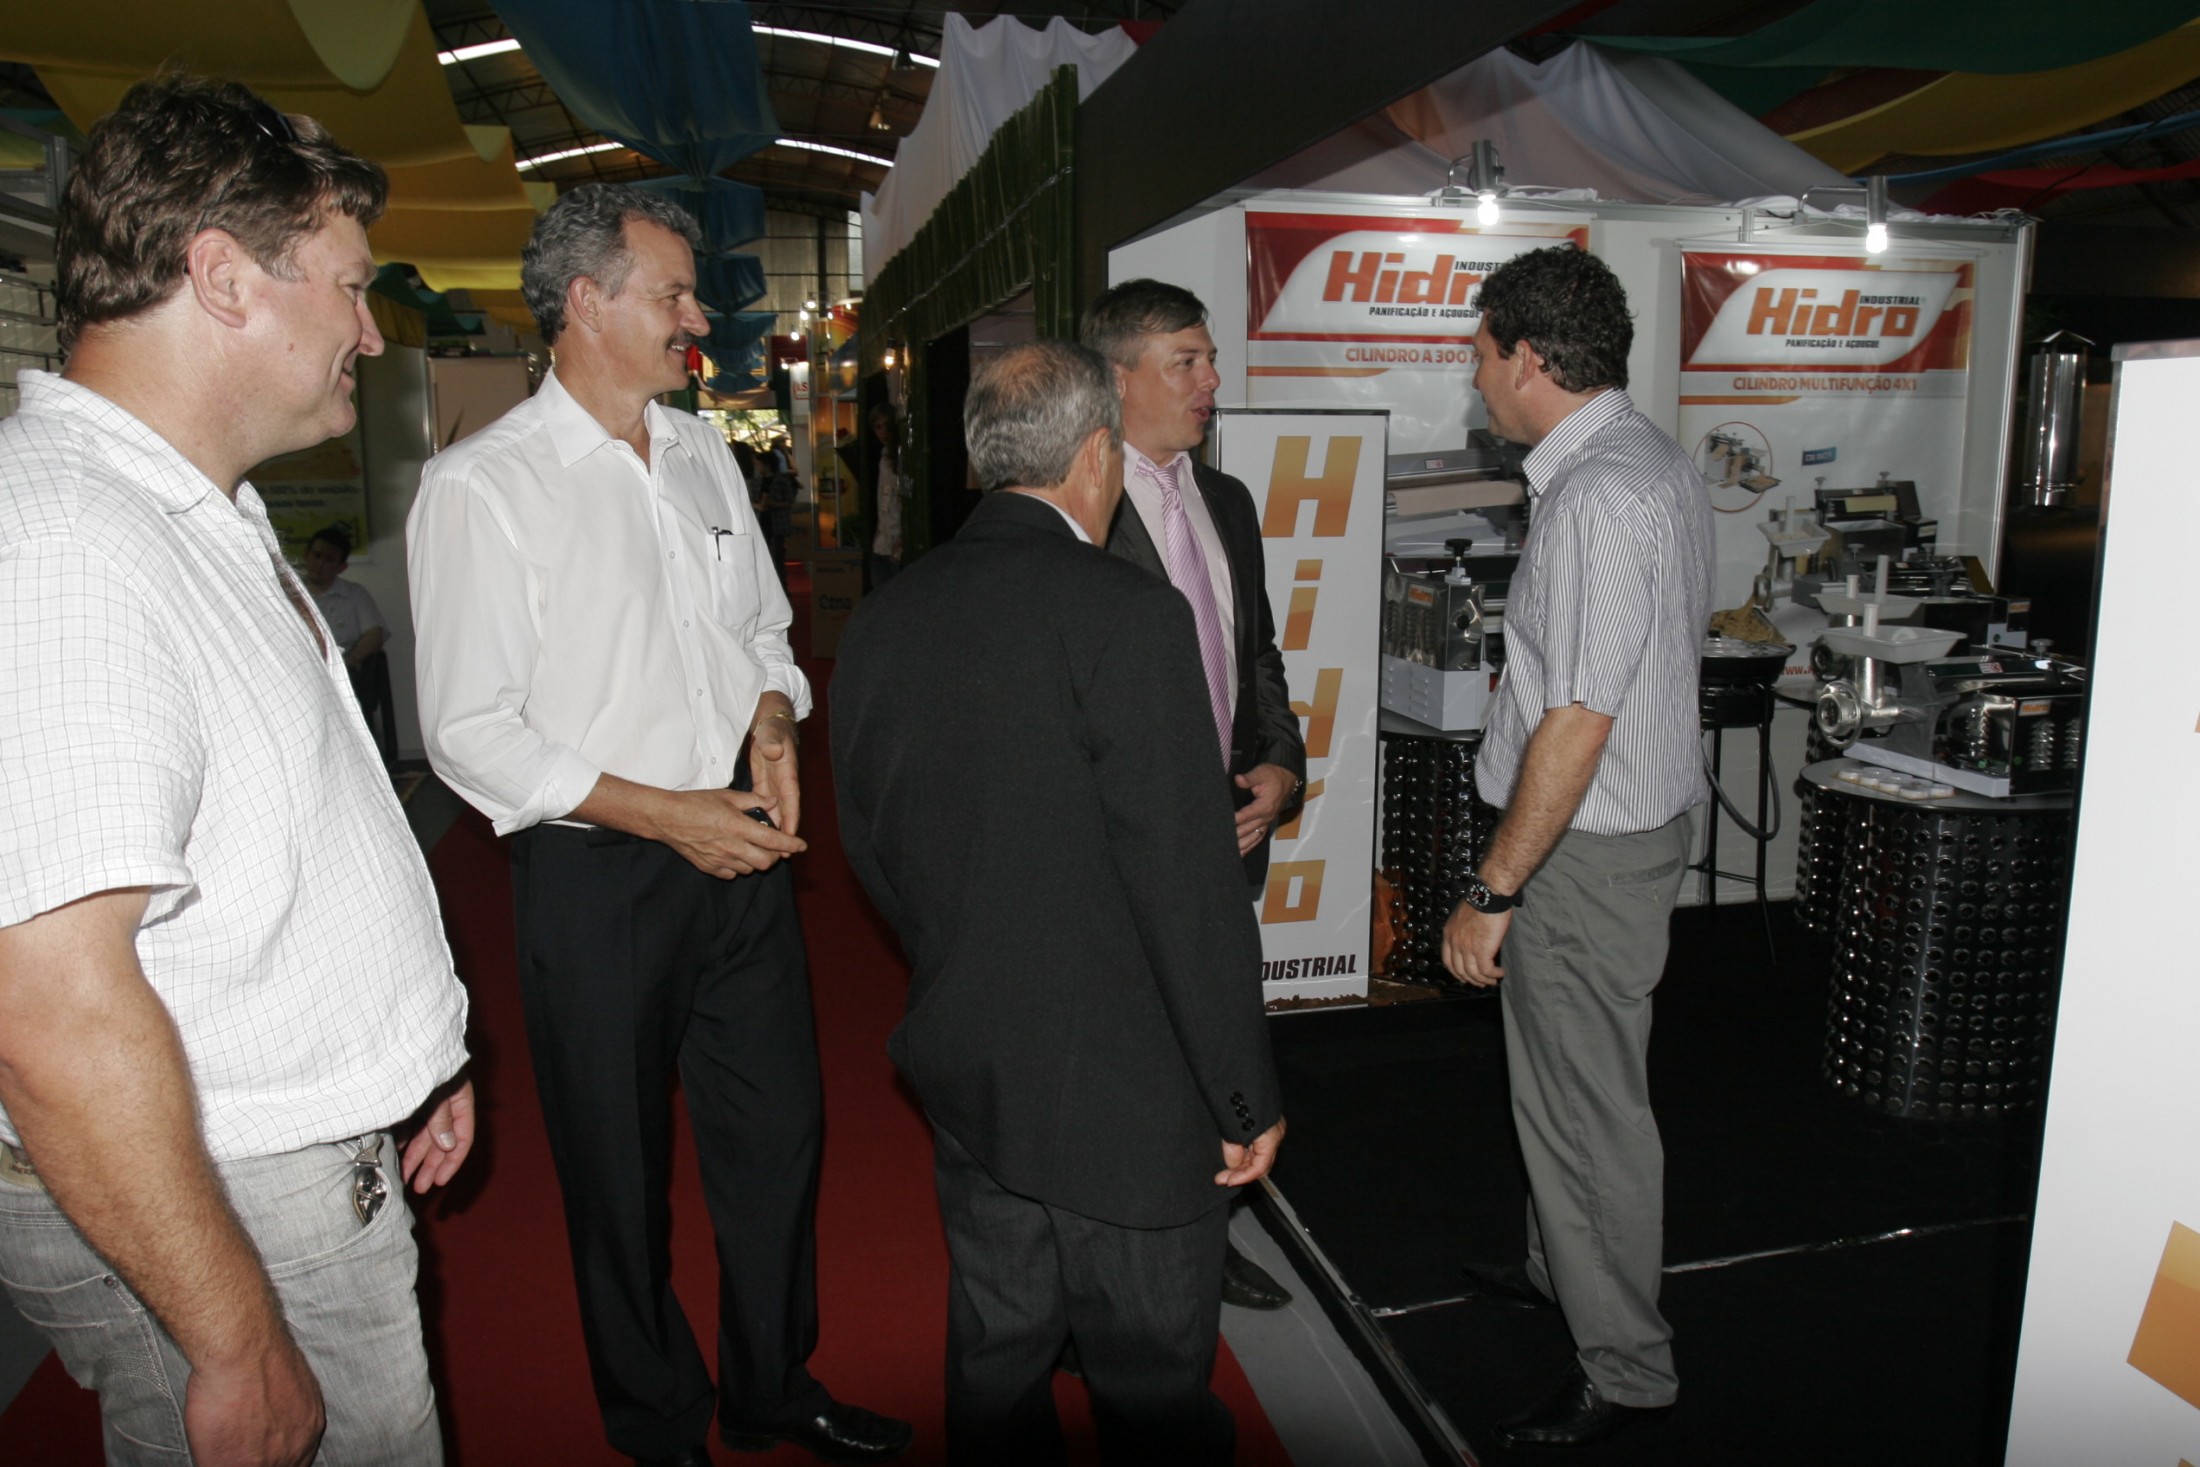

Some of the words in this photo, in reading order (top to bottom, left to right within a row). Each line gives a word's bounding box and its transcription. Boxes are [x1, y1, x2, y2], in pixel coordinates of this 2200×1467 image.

[1455, 261, 1502, 271] INDUST
[1323, 251, 1482, 305] Hidr
[1859, 295, 1920, 305] INDUSTRIAL
[1369, 307, 1428, 317] PANIFICAÇÃO
[1432, 309, 1437, 317] E
[1439, 309, 1480, 318] AÇOUGUE
[1746, 287, 1920, 337] Hidro
[1785, 338, 1836, 349] PANIFICAÇÃO
[1345, 348, 1419, 362] CILINDRO
[1422, 350, 1433, 363] A
[1436, 350, 1467, 363] 300
[1732, 377, 1797, 390] CILINDRO
[1801, 376, 1891, 394] MULTIFUNÇÃO
[1261, 954, 1357, 981] DUSTRIAL
